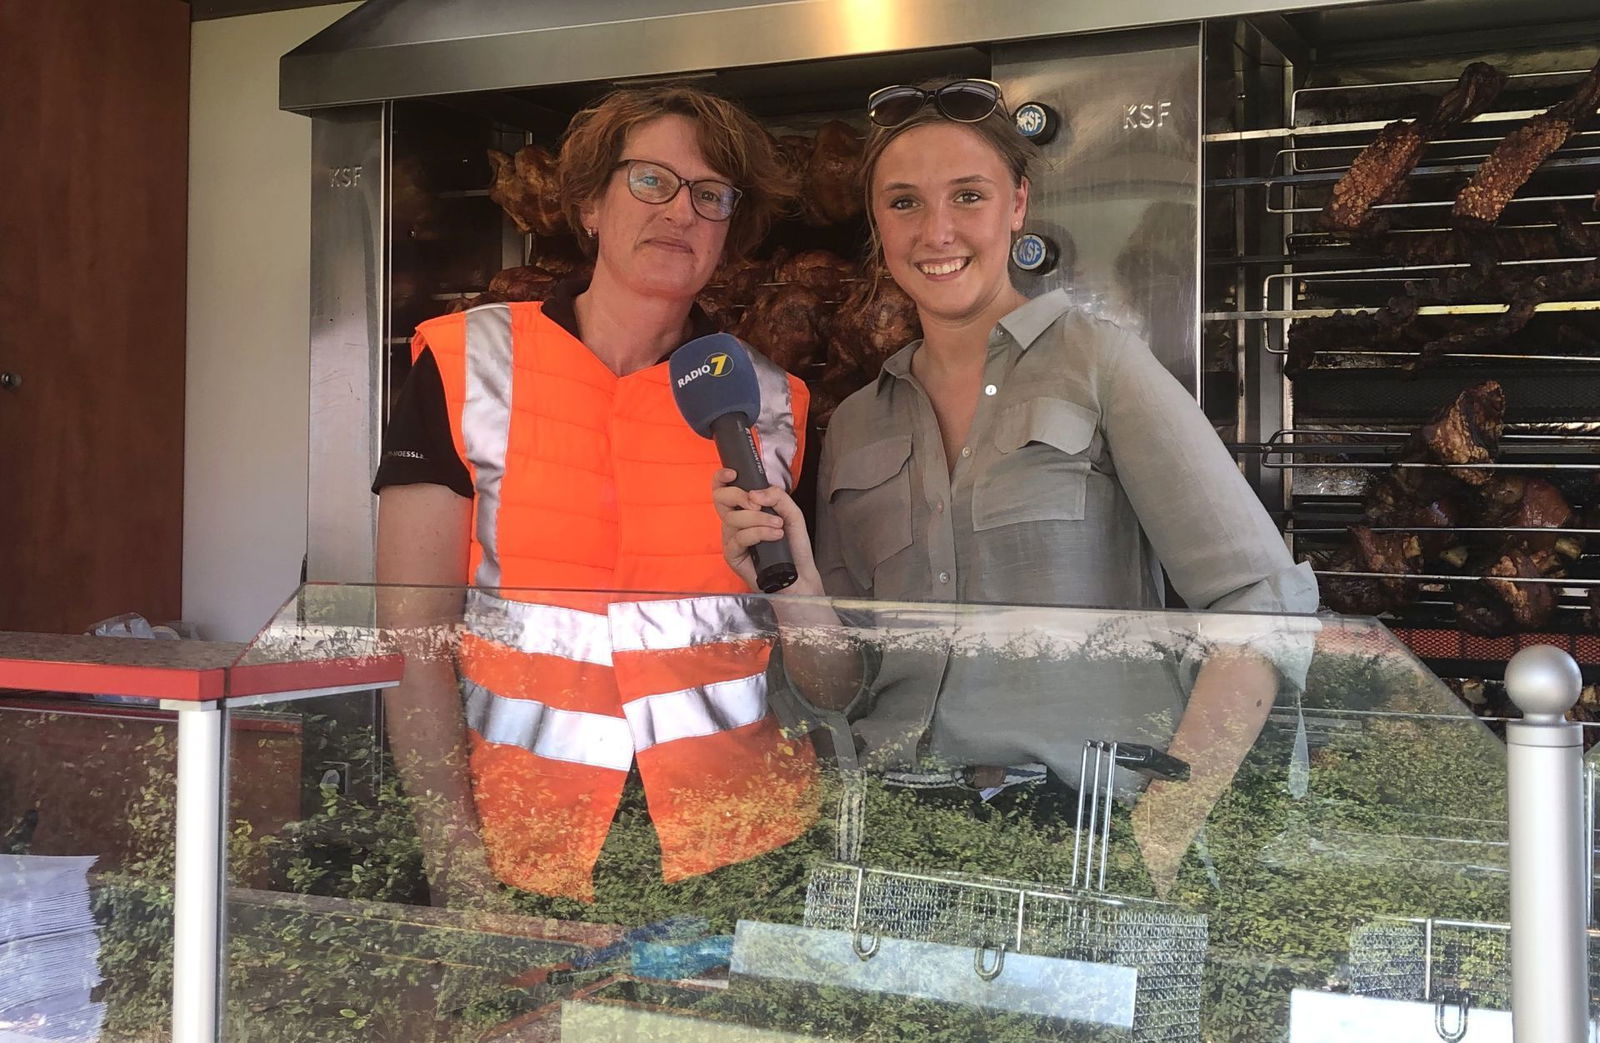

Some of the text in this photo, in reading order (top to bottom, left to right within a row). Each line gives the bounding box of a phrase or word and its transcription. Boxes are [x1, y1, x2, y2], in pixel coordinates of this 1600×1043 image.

[1123, 101, 1172, 130] KSF
[329, 166, 363, 188] KSF
[1018, 241, 1042, 262] KSF
[677, 354, 728, 388] RADIO 7
